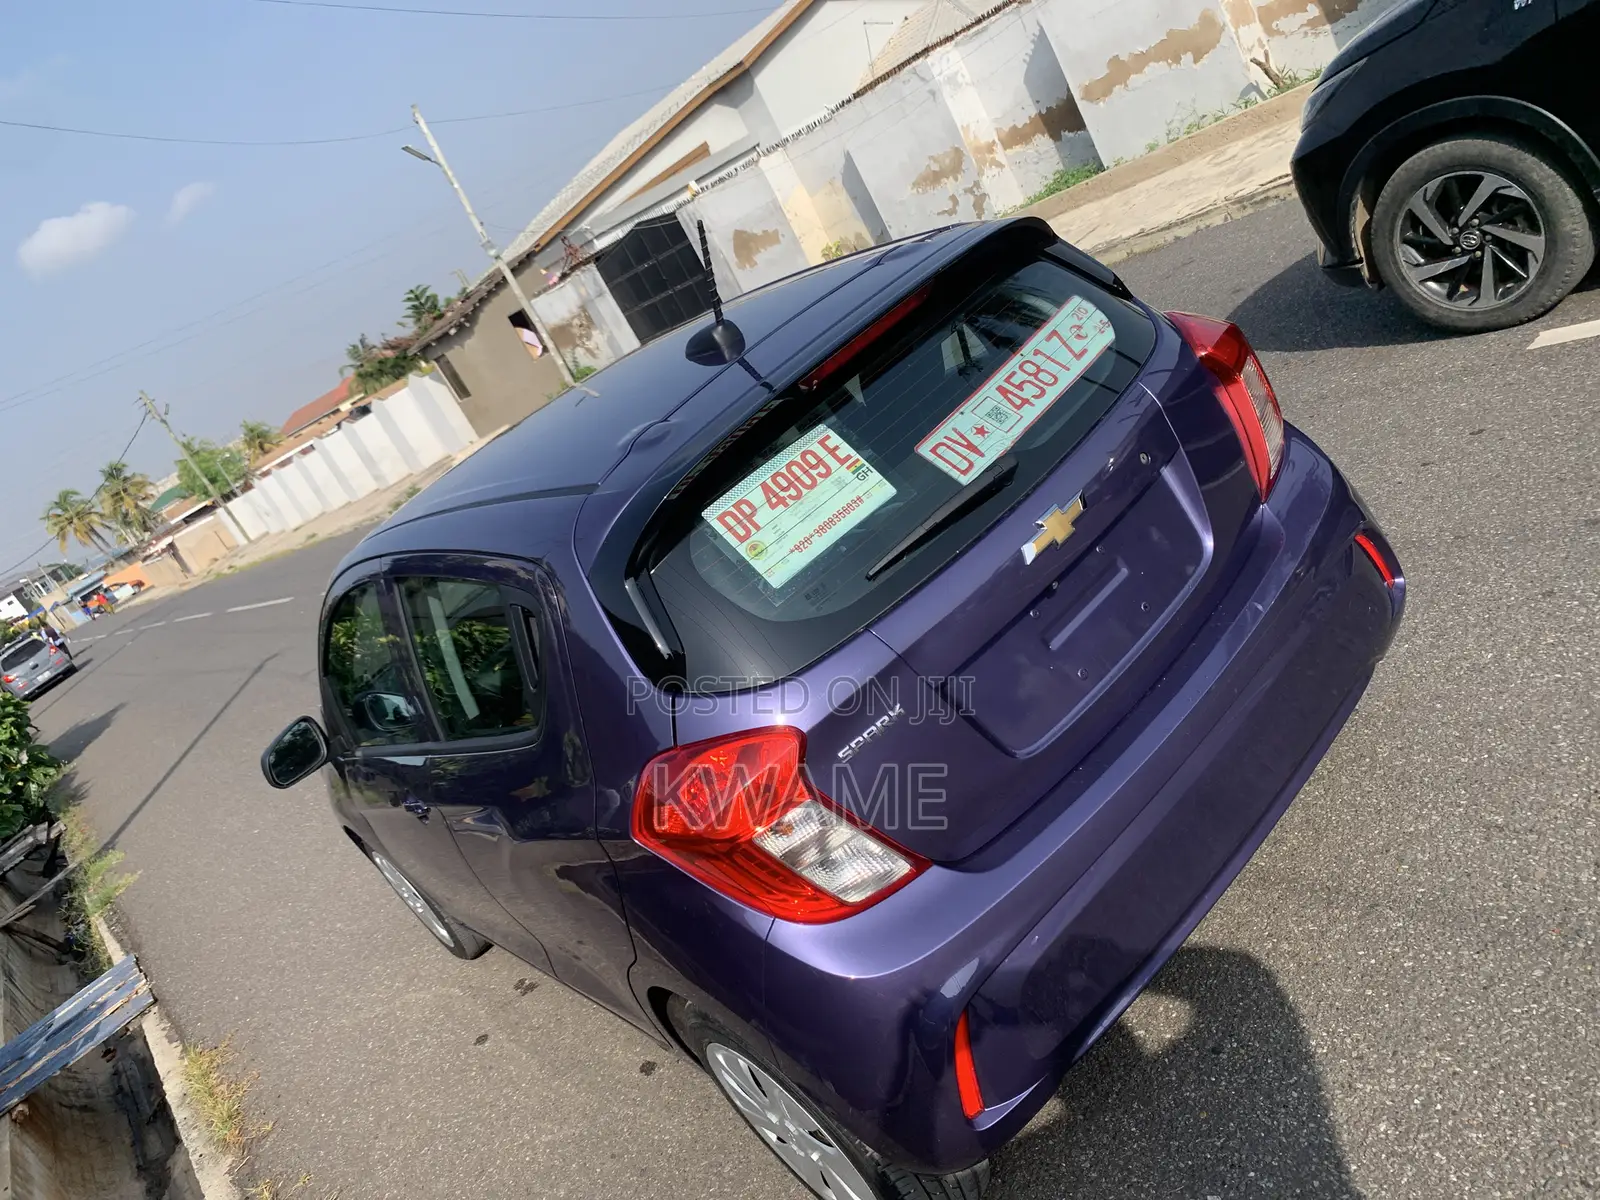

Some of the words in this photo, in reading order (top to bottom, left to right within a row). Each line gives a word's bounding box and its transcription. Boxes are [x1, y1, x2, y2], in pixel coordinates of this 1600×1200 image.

[929, 427, 986, 477] DV
[995, 348, 1071, 411] 4581
[1045, 329, 1088, 361] Z
[715, 498, 761, 544] DP
[759, 449, 832, 511] 4909
[817, 434, 854, 467] E
[856, 466, 873, 482] GH
[838, 703, 905, 763] SPARK
